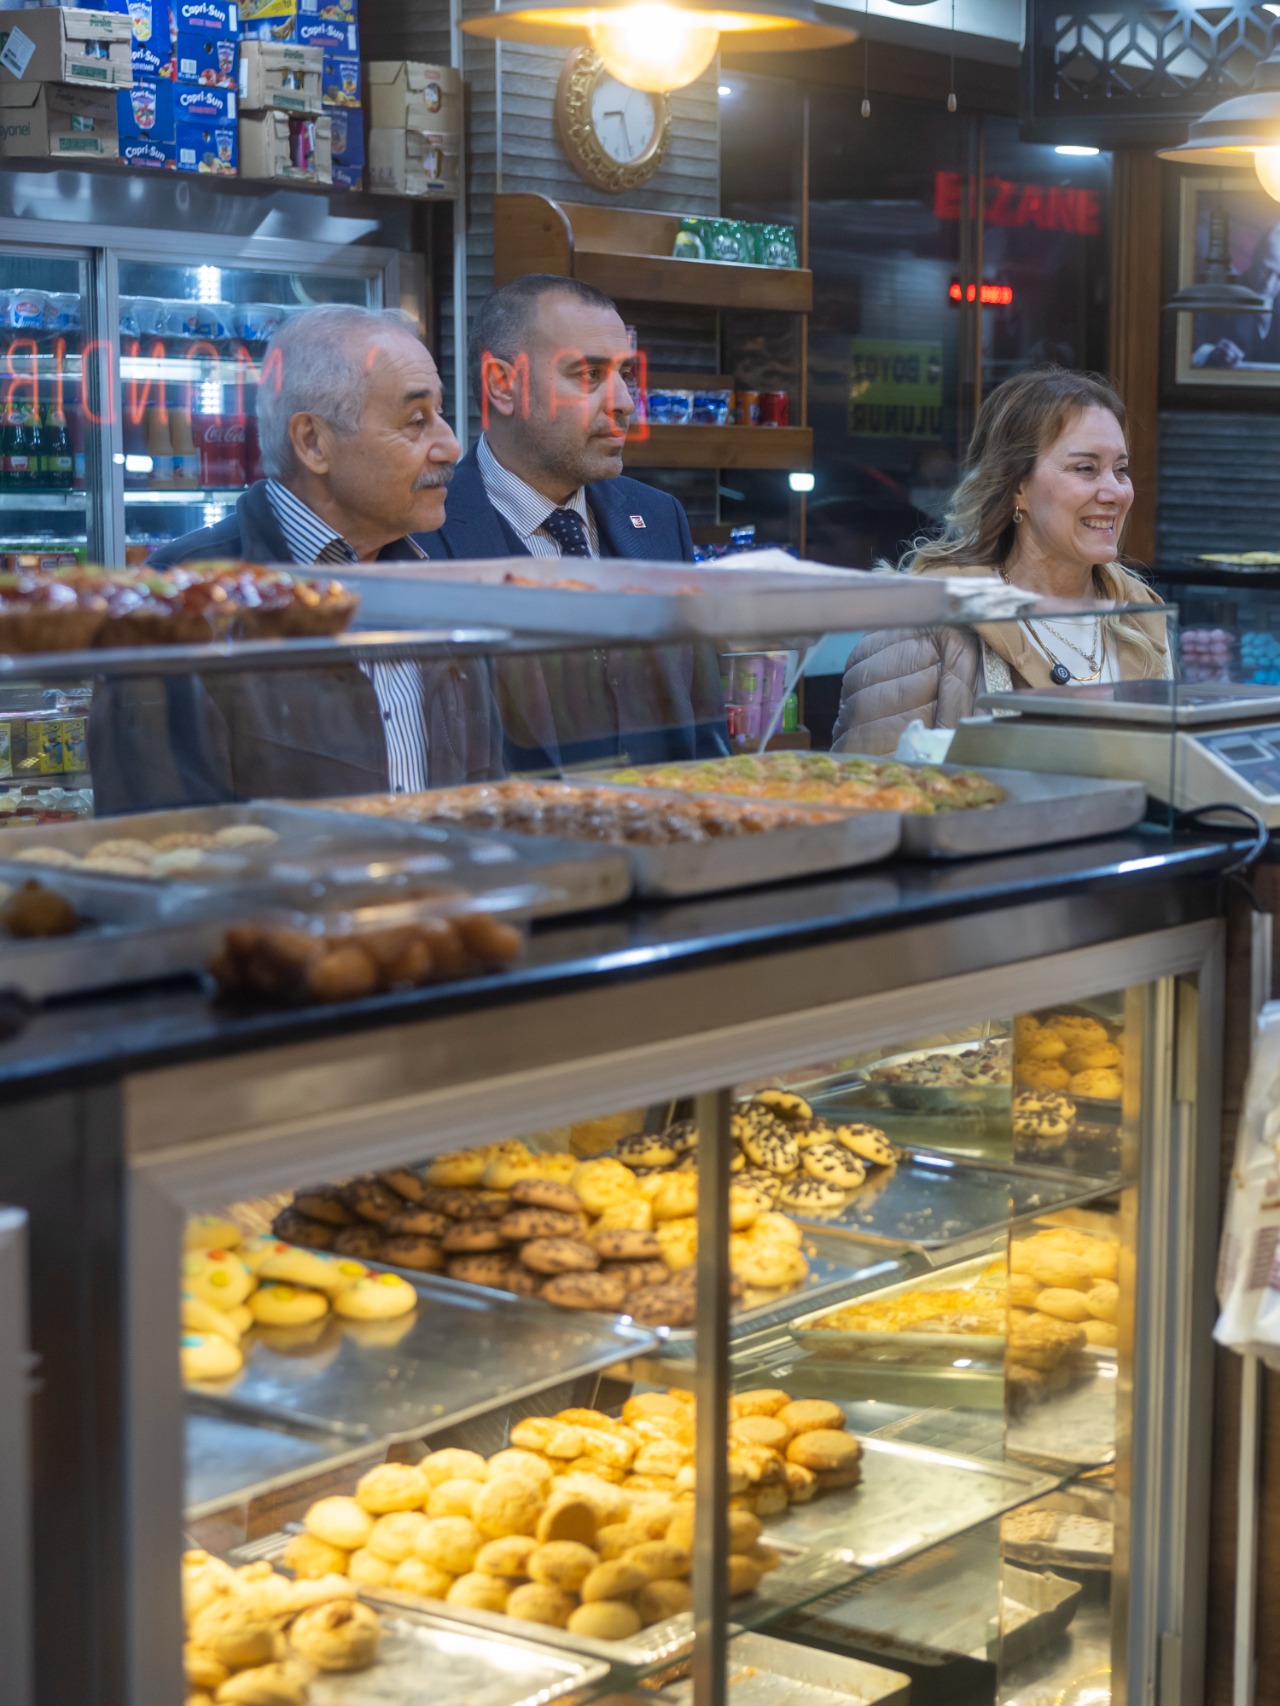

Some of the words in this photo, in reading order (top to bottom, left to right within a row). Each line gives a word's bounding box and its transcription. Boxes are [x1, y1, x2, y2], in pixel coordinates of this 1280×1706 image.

[182, 3, 226, 21] Capri-Sun
[301, 23, 345, 40] Capri-Sun
[131, 48, 160, 67] pri-Sun
[180, 91, 224, 109] Capri-Sun
[125, 144, 166, 162] Capri-Sun
[933, 170, 1100, 236] EZANE
